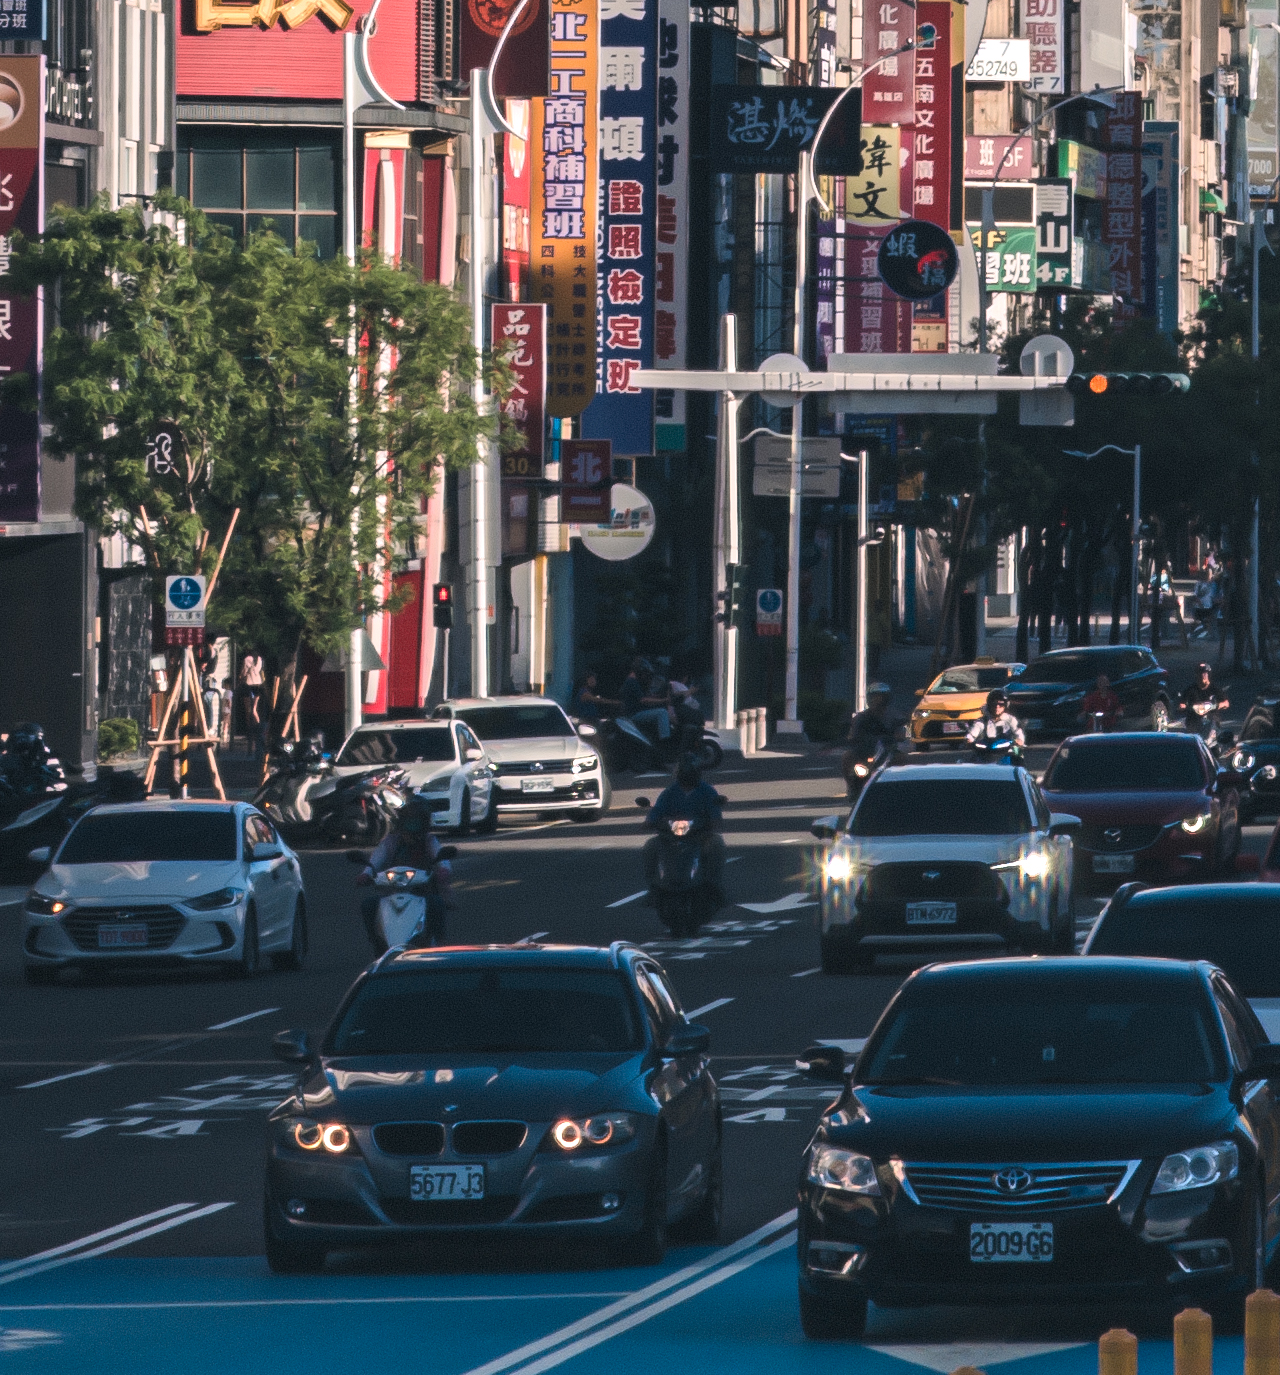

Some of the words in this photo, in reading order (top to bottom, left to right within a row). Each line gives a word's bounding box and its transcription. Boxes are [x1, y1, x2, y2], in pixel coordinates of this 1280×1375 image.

[543, 12, 588, 239] 北一工商科補習班
[914, 58, 935, 206] 五南文化廣場
[1035, 184, 1070, 254] 青山
[1036, 261, 1070, 284] 4F
[606, 179, 644, 394] 證照檢定班
[970, 1231, 1053, 1257] 2009-G6
